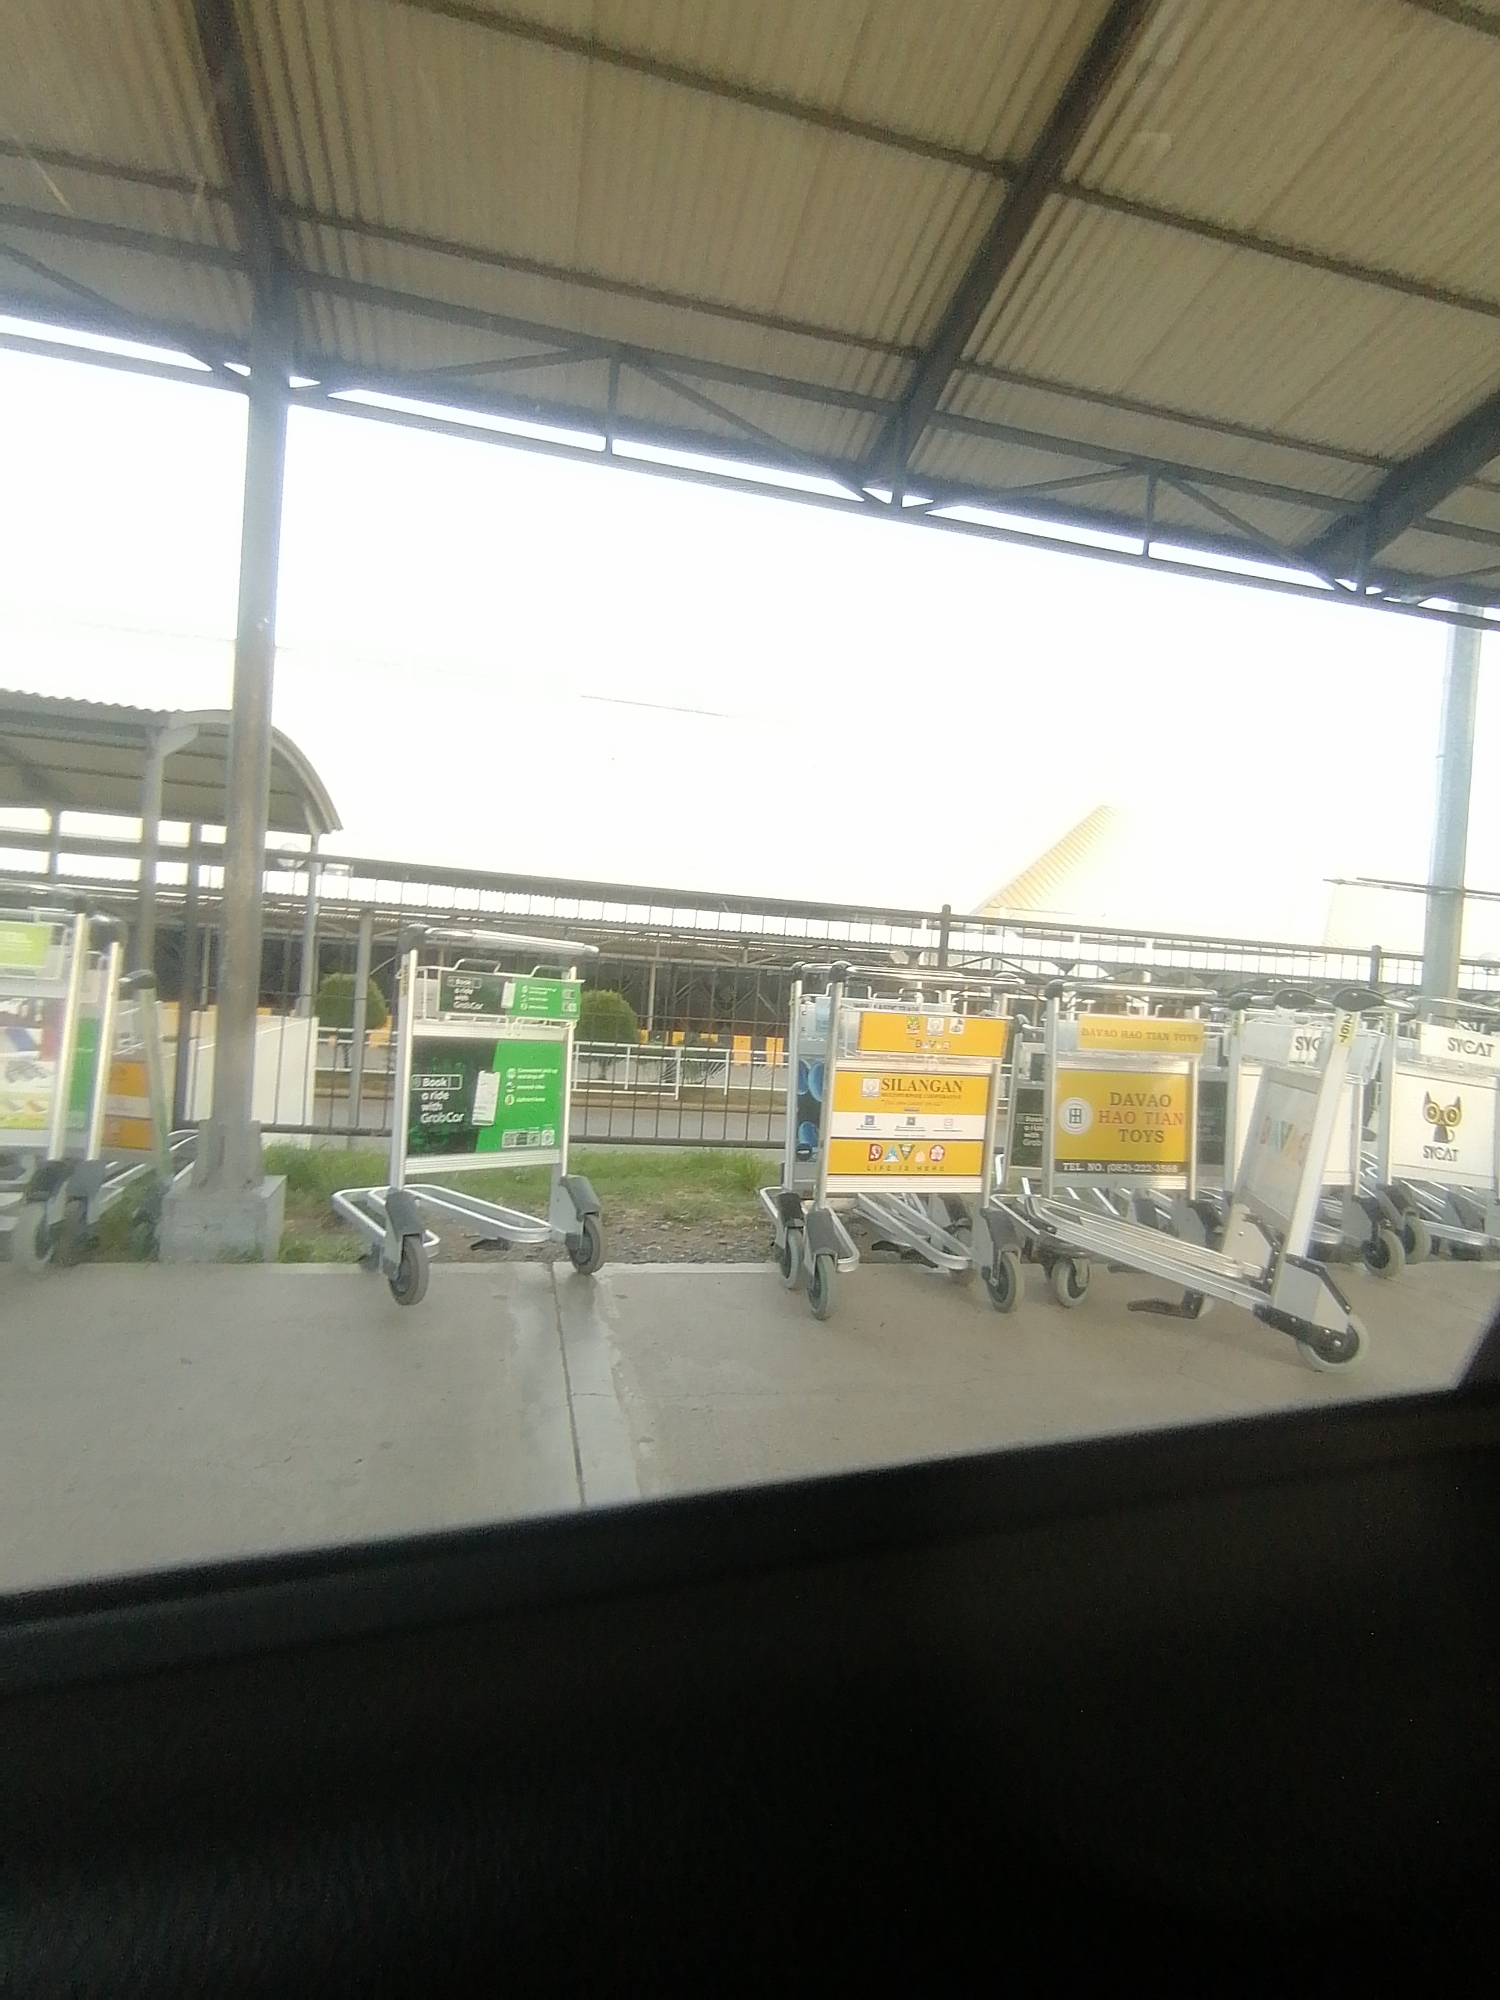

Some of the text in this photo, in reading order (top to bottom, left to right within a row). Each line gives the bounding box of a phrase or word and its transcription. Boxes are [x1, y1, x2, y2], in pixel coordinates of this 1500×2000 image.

[1081, 1028, 1199, 1042] DAVAO HAO TIAN TOYS
[422, 1077, 448, 1087] Book
[881, 1078, 964, 1092] SILANGAN
[421, 1091, 449, 1100] a ride
[1109, 1092, 1172, 1107] DAVAO
[421, 1102, 443, 1111] with
[420, 1112, 465, 1124] GrabCar
[1098, 1110, 1136, 1125] HAO
[1144, 1111, 1184, 1126] TIAN
[1118, 1129, 1165, 1143] TOYS
[1062, 1162, 1085, 1171] TEL.
[1087, 1163, 1105, 1171] NO.
